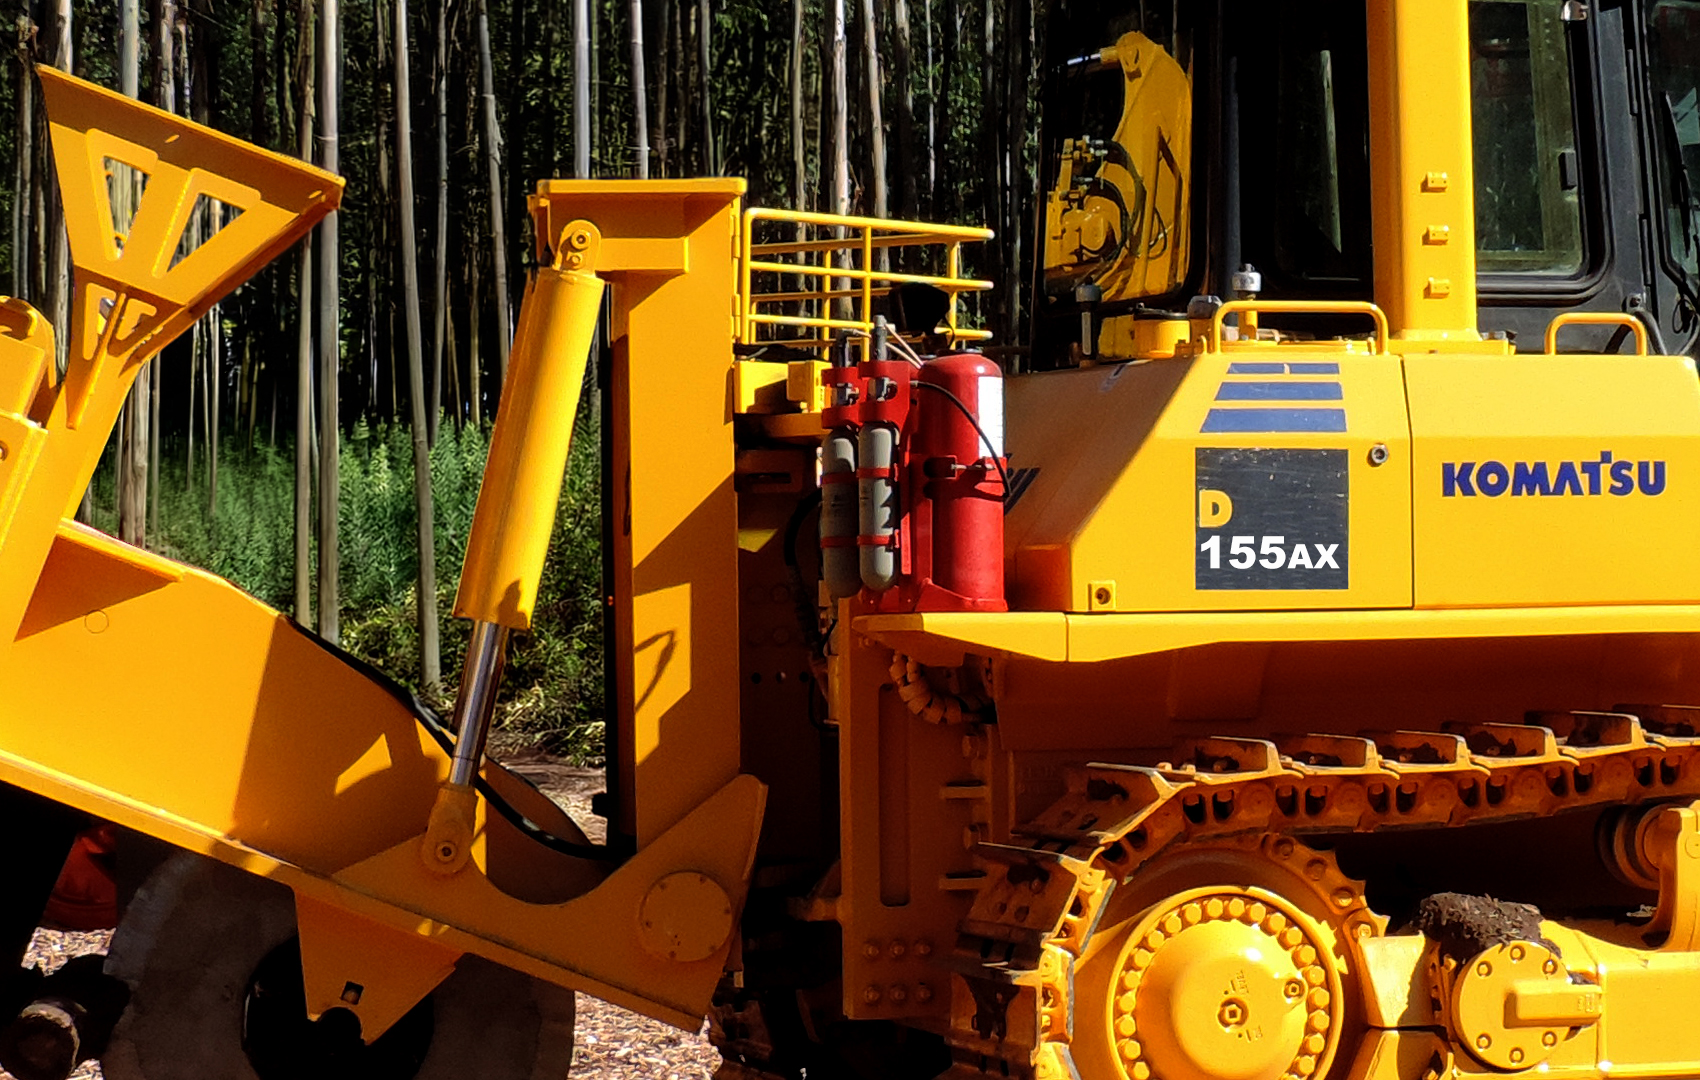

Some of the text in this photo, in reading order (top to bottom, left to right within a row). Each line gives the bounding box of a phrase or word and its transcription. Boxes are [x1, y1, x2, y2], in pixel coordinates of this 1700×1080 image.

[1442, 450, 1666, 497] KOMATSU
[1199, 489, 1233, 528] D
[1200, 535, 1341, 570] 155AX
